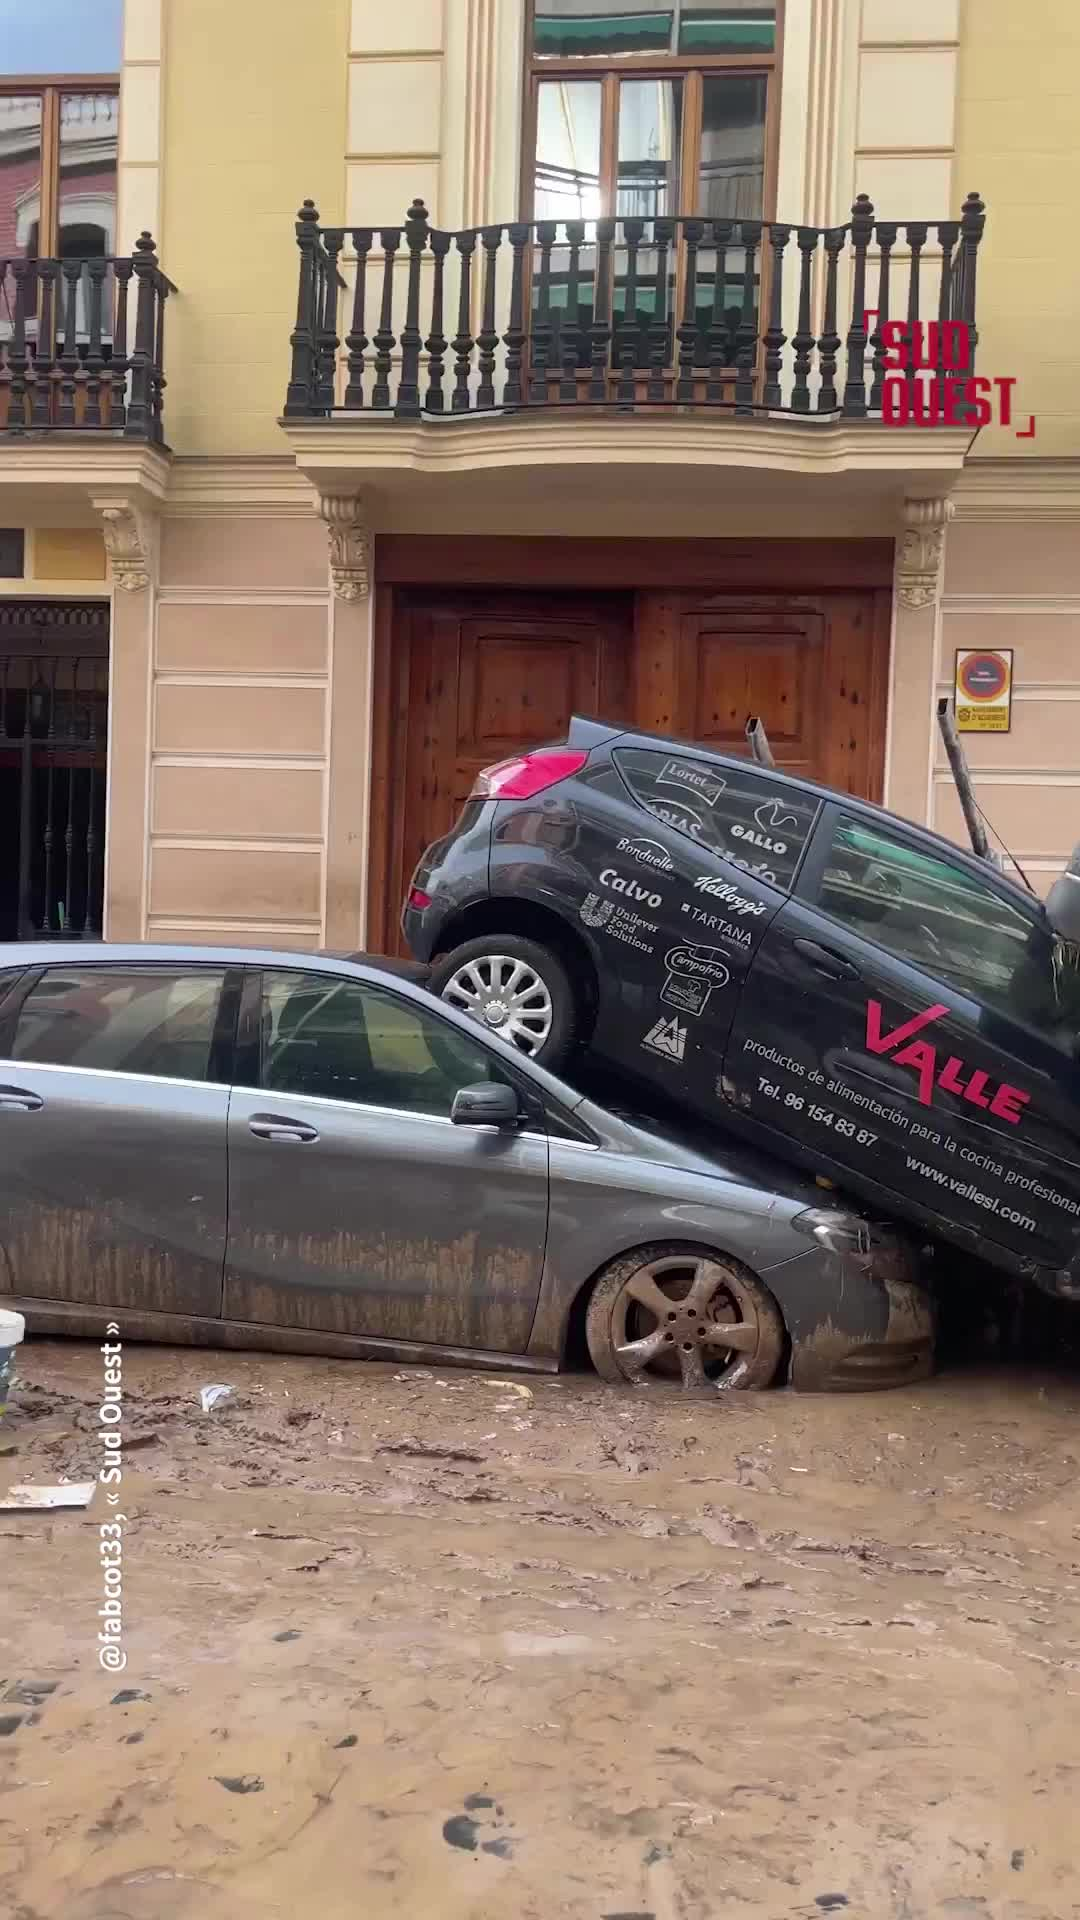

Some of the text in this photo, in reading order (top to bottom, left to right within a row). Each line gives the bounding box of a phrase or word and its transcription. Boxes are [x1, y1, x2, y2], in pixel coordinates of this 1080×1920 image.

[616, 837, 674, 872] Bonduelle
[730, 824, 788, 855] GALLO
[599, 868, 663, 908] Calvo
[694, 876, 767, 916] Kellogg's
[606, 925, 654, 954] Solutions
[610, 915, 637, 934] Food
[615, 907, 659, 933] Unilever
[691, 907, 752, 945] TARTANA
[866, 999, 1031, 1125] VALLE
[743, 1038, 806, 1077] productos
[807, 1069, 825, 1085] de
[826, 1079, 909, 1129] alimentación
[909, 1122, 941, 1145] para
[944, 1135, 957, 1153] la
[960, 1147, 1003, 1177] cocina
[757, 1076, 880, 1148] Tel. 96 154 83 87
[906, 1155, 1037, 1233] www.vallesl.com
